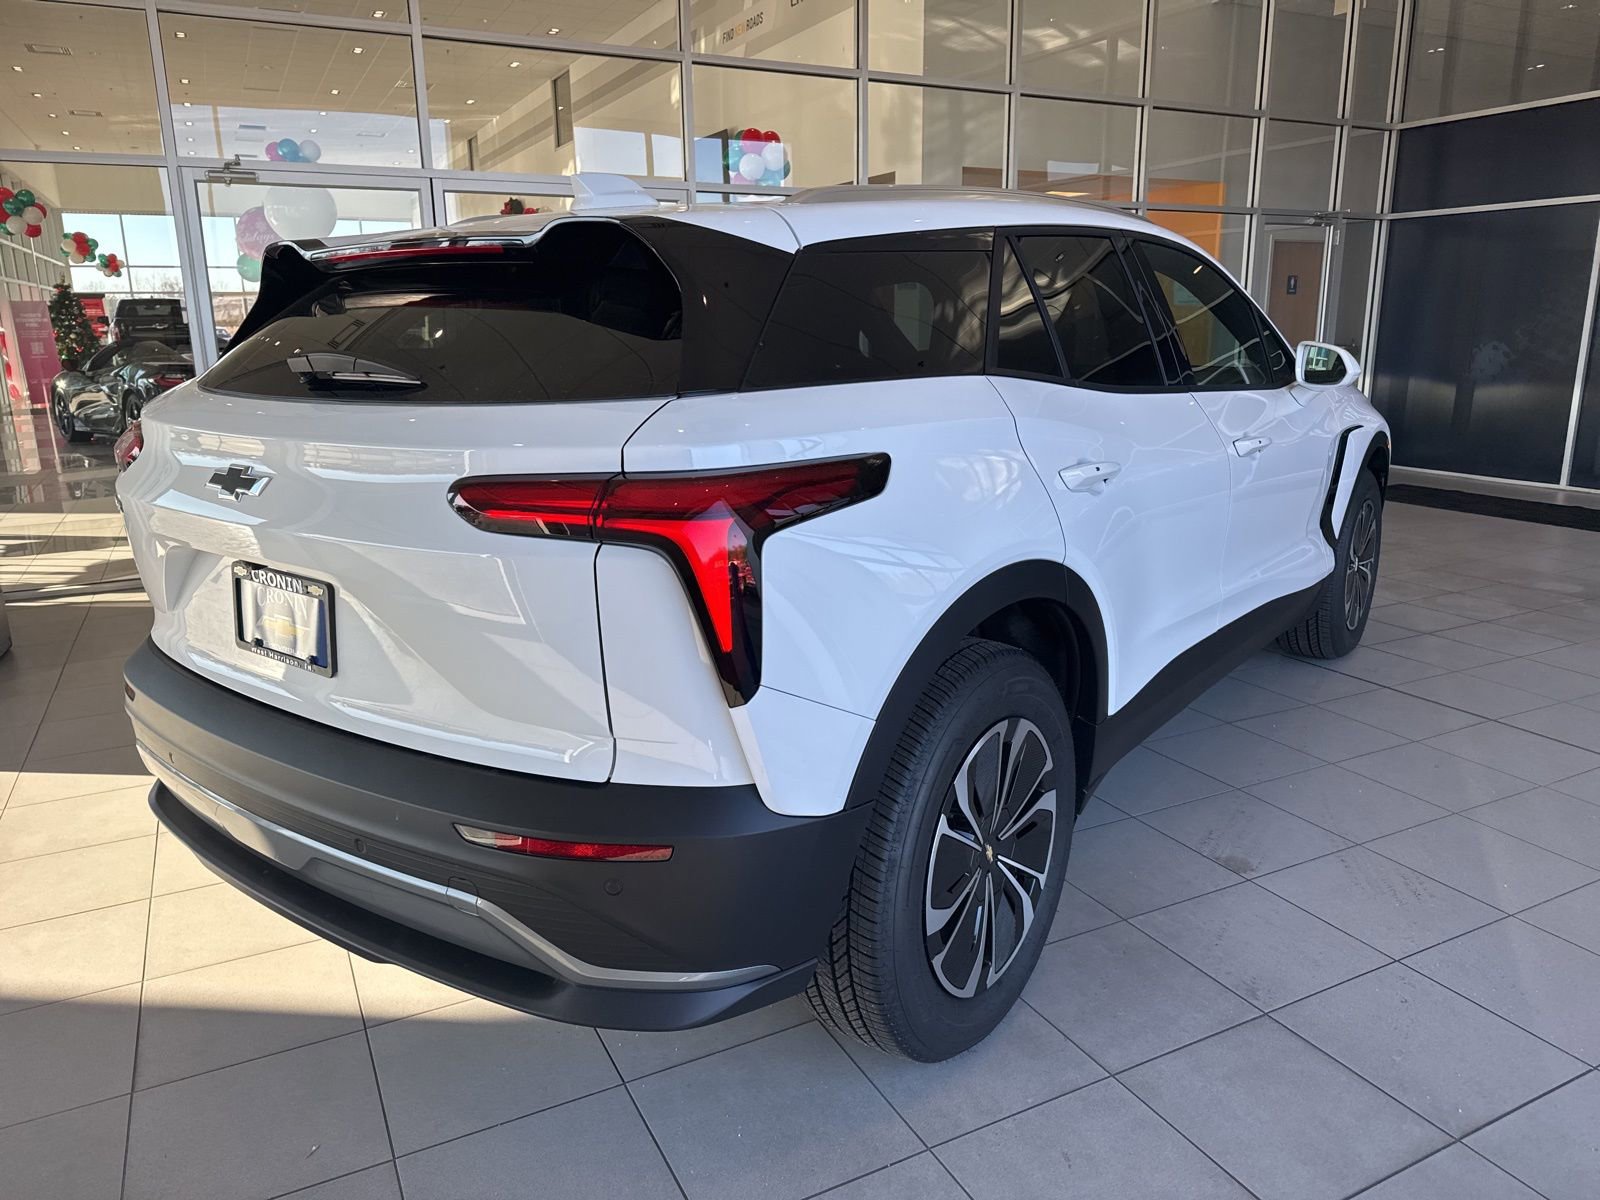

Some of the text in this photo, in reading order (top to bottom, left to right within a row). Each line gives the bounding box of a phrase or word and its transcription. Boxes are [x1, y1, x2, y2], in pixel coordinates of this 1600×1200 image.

[723, 28, 734, 44] FIND
[746, 12, 763, 31] ROADS
[251, 569, 303, 594] CRONIN
[256, 585, 308, 618] CRONIN
[269, 650, 301, 668] Harrison,
